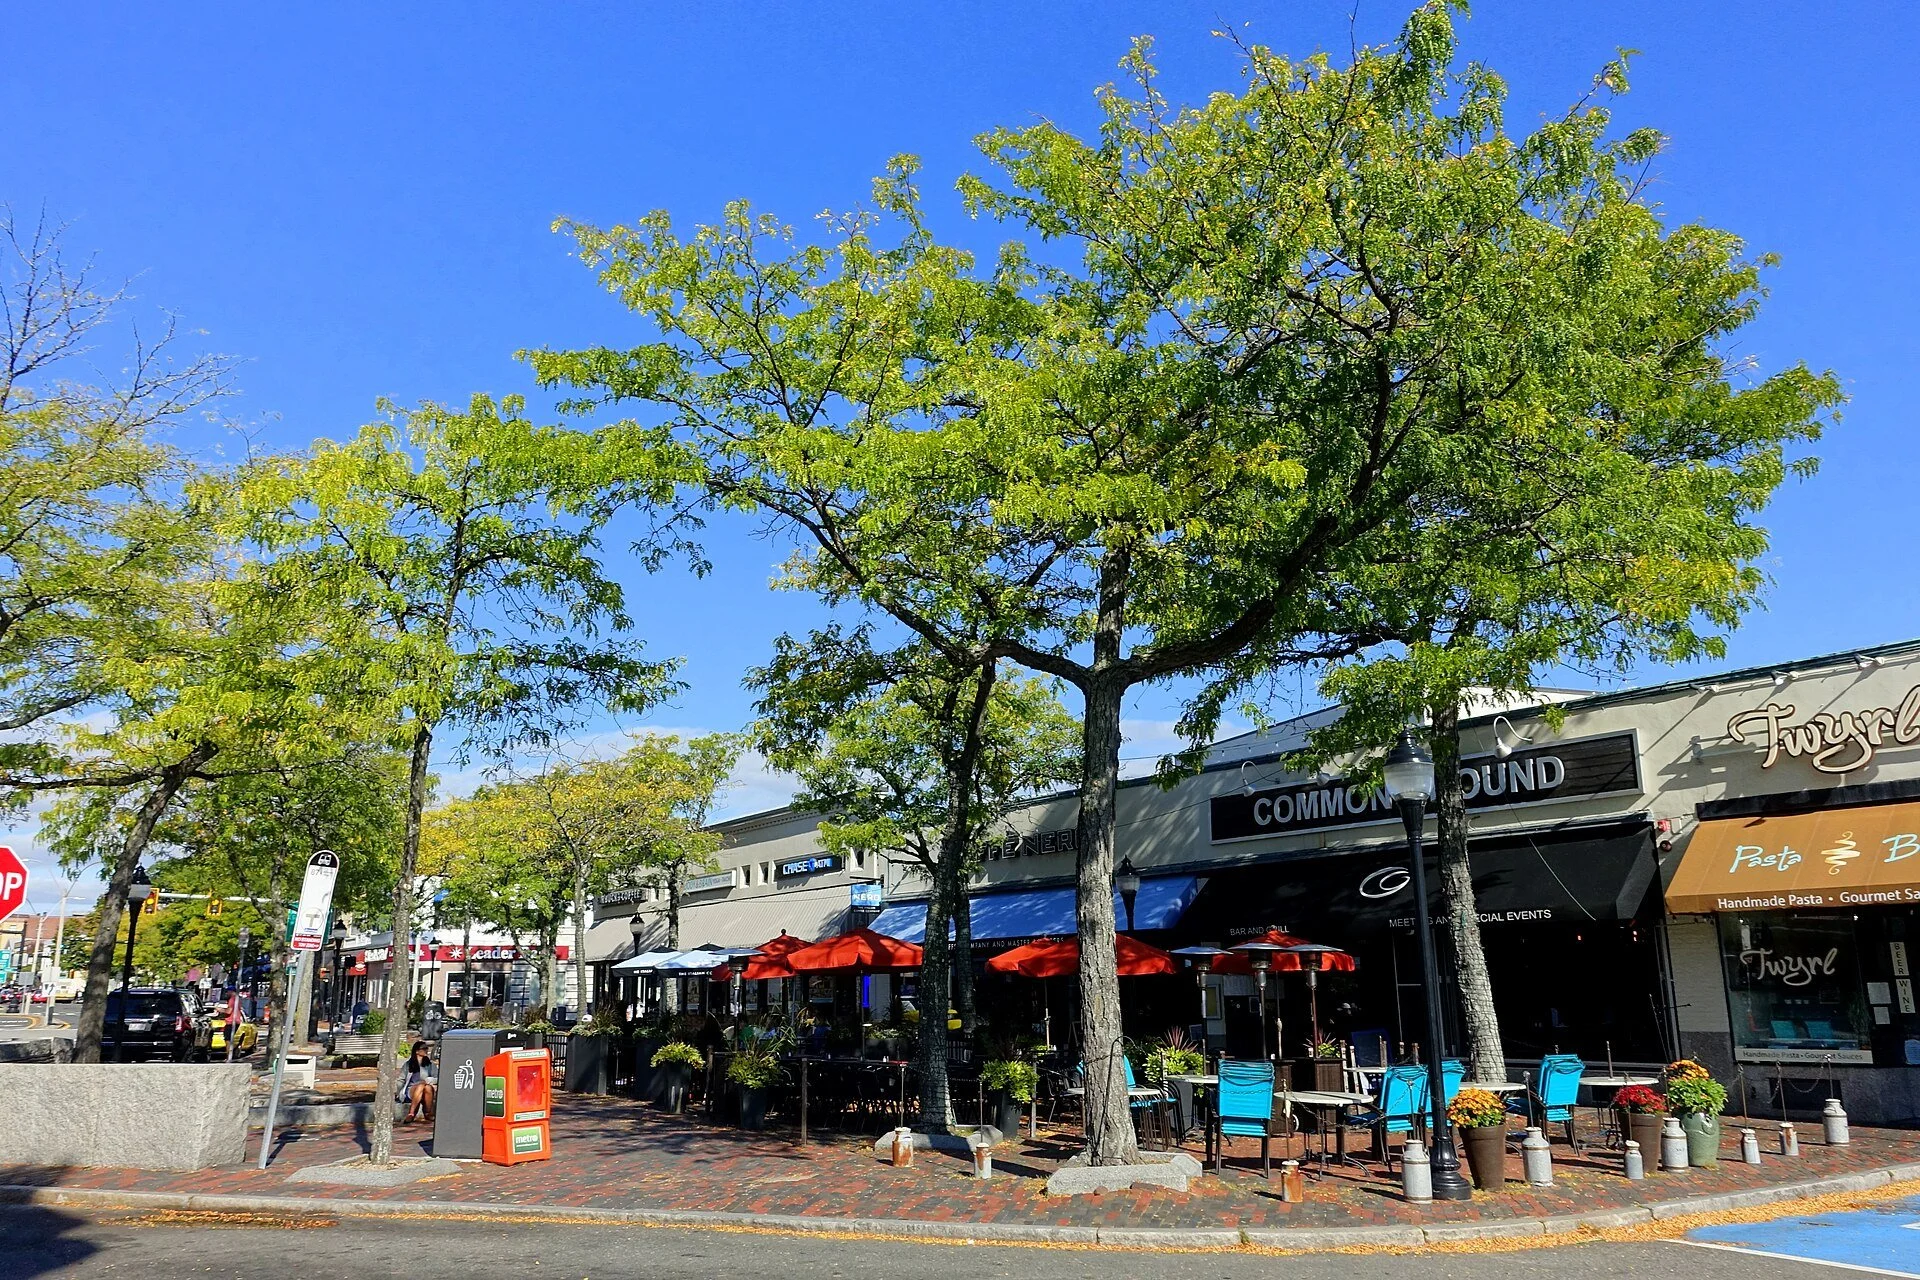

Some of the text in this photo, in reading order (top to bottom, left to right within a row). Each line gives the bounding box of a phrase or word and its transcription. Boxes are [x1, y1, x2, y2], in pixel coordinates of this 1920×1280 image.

[1728, 685, 1920, 774] Twyrl
[1253, 755, 1565, 825] COMMON OUND
[1022, 828, 1079, 856] NER
[783, 861, 807, 875] CHASE
[1729, 845, 1802, 874] Pasta
[1718, 895, 1786, 909] Handmade
[1788, 894, 1823, 906] Pasta
[1840, 889, 1901, 904] Gourmet
[1435, 915, 1450, 925] AN
[1475, 912, 1505, 923] ECIAL
[1507, 909, 1552, 921] EVENTS
[1230, 928, 1246, 936] BAR
[1247, 926, 1265, 934] AND
[970, 941, 990, 949] MPANY
[992, 940, 1005, 948] AND
[1740, 948, 1838, 986] Twyrl
[1894, 943, 1905, 975] BEER
[1900, 980, 1911, 1013] WINE
[1743, 1050, 1780, 1058] Handmade
[1781, 1051, 1800, 1059] Pasta
[1837, 1052, 1863, 1060] Sauces
[486, 1088, 504, 1099] metro
[515, 1134, 539, 1144] metro
